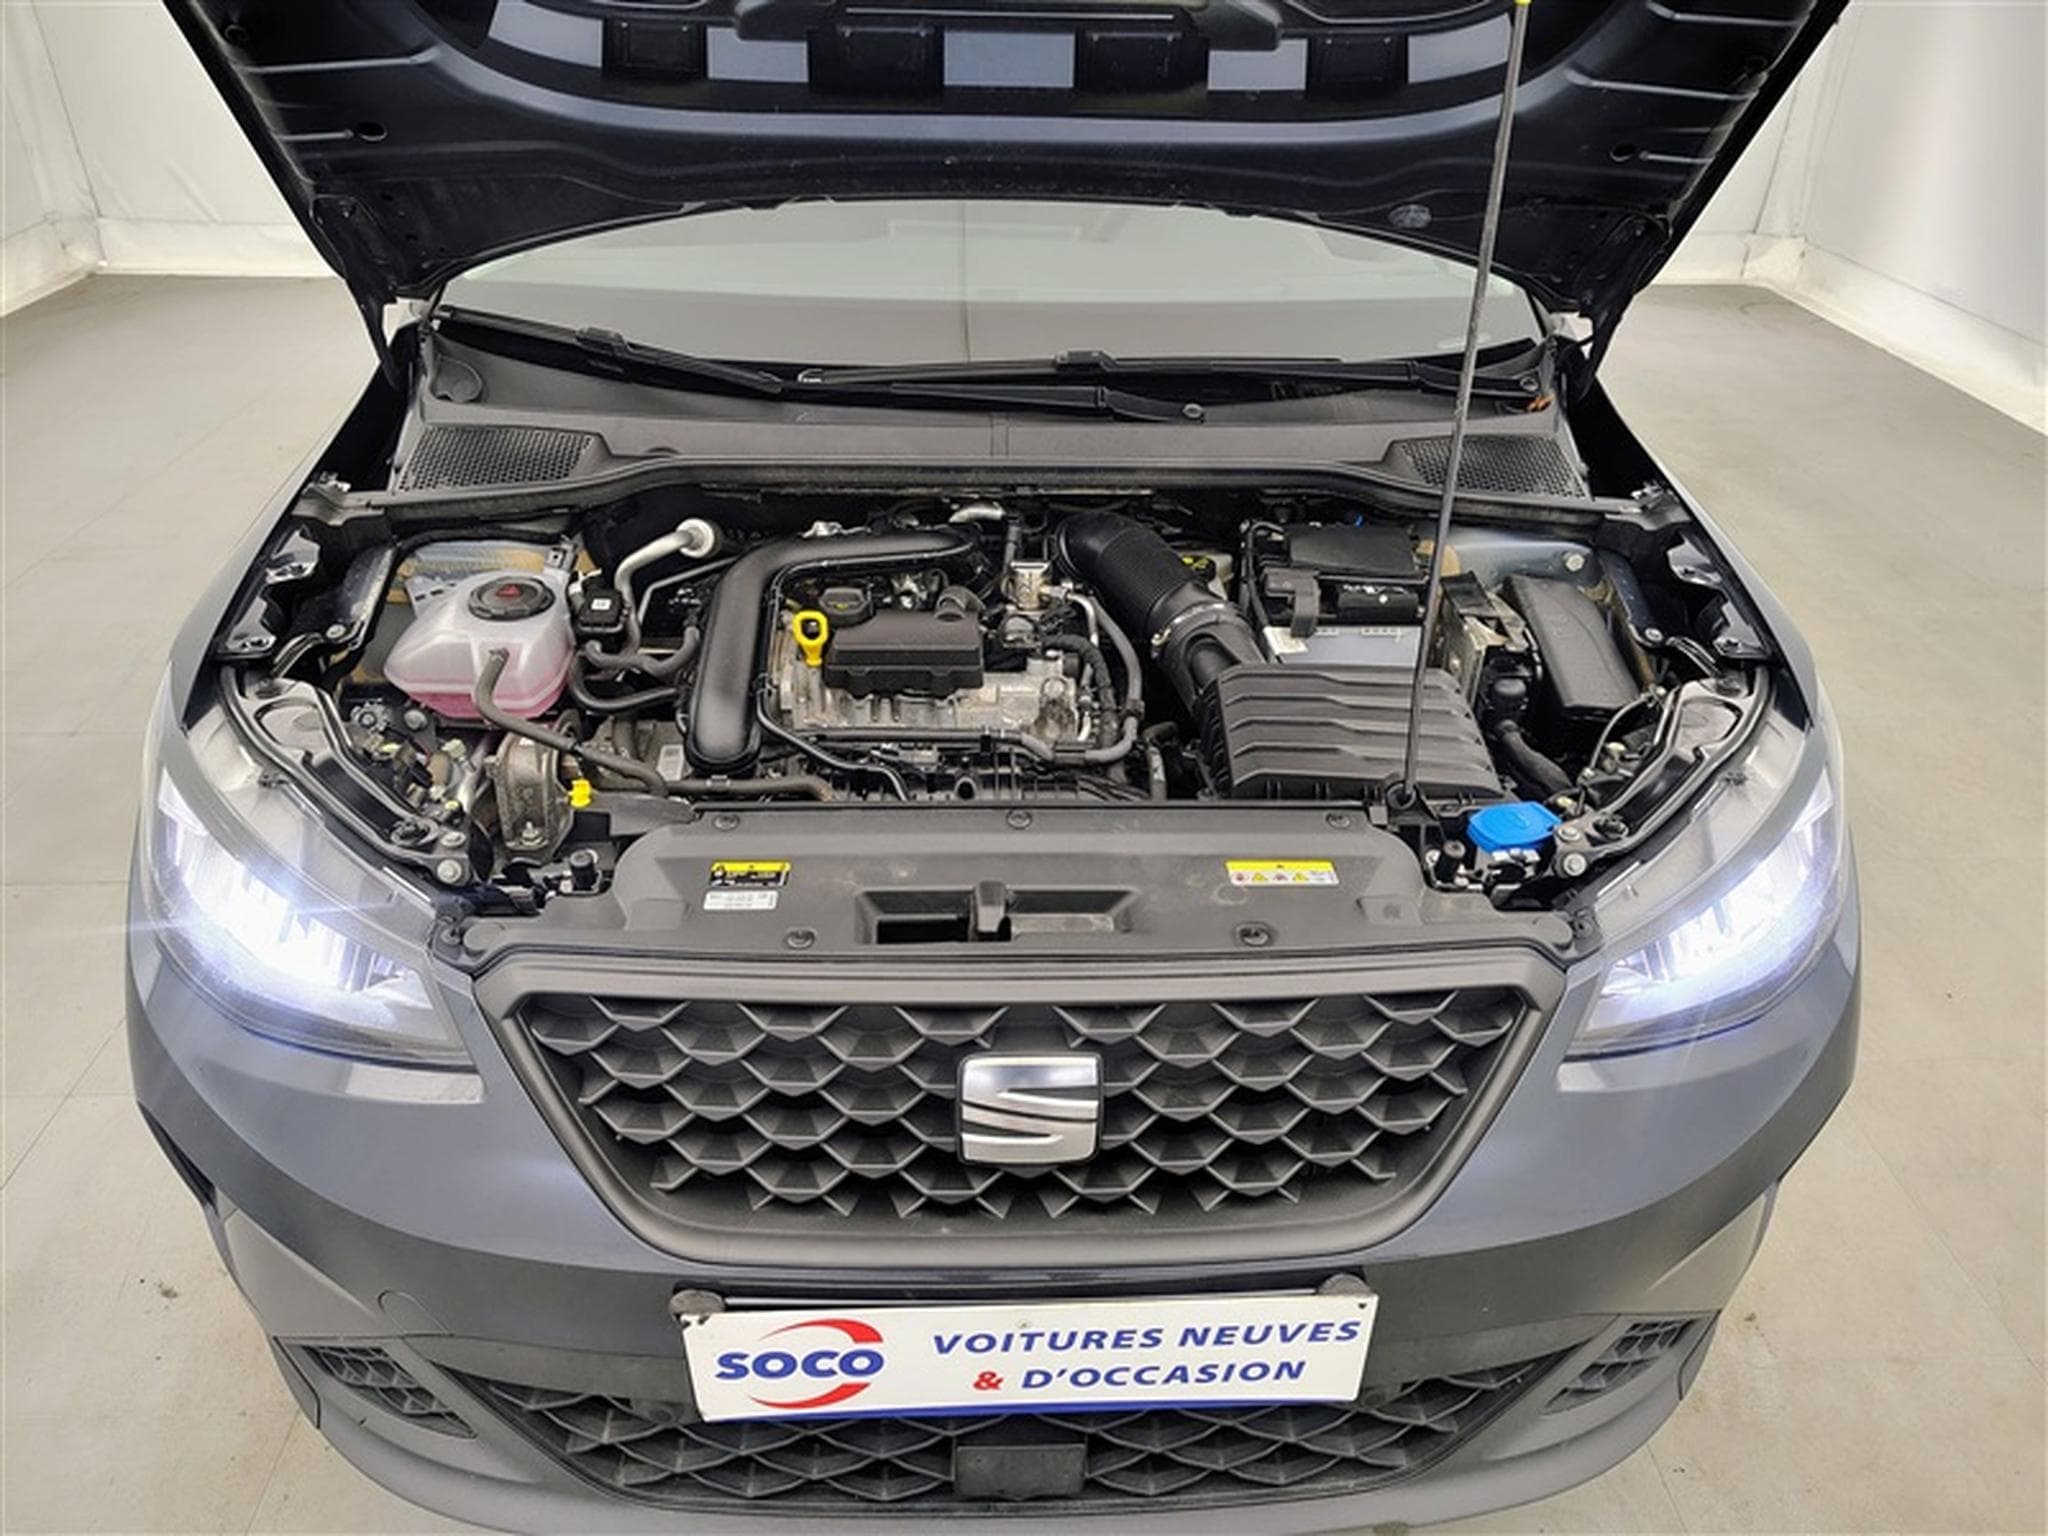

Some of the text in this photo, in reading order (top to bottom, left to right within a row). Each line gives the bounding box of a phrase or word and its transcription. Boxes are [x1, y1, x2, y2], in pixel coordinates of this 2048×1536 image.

[933, 1320, 1362, 1355] VOITURES NEUVES
[714, 1348, 885, 1380] SOCO
[972, 1360, 1306, 1391] & D'OCCASION
